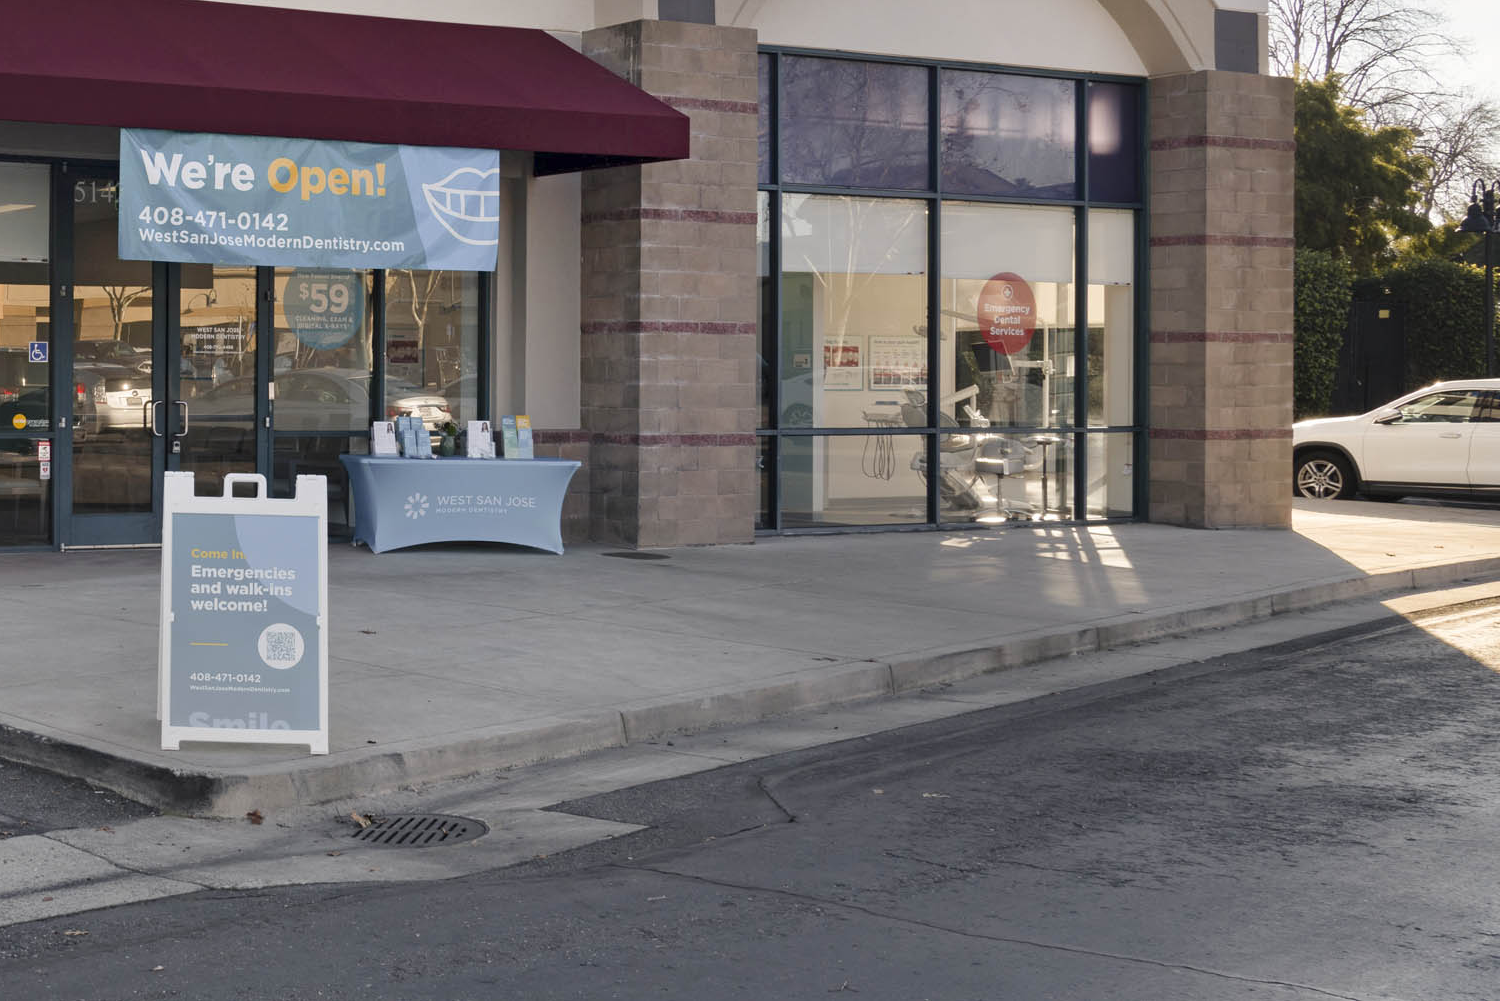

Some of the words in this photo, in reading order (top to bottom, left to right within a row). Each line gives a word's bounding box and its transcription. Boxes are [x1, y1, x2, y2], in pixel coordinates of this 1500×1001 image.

[140, 149, 255, 192] We're
[267, 157, 387, 201] Open!
[74, 180, 120, 203] 514
[138, 205, 289, 231] 408-471-0142
[138, 228, 406, 254] WestSanJoseModernDentistry.com
[299, 282, 349, 314] $59
[984, 303, 1030, 315] Emergency
[995, 315, 1021, 325] Dental
[990, 326, 1025, 336] Services
[437, 495, 473, 505] WEST
[476, 495, 502, 506] SAN
[506, 496, 537, 508] JOSE
[190, 548, 228, 559] Come
[190, 564, 297, 581] Emergencies
[190, 581, 221, 594] and
[226, 582, 293, 596] walk-ins
[190, 597, 268, 612] welcome!
[190, 672, 261, 683] 408-471-0142
